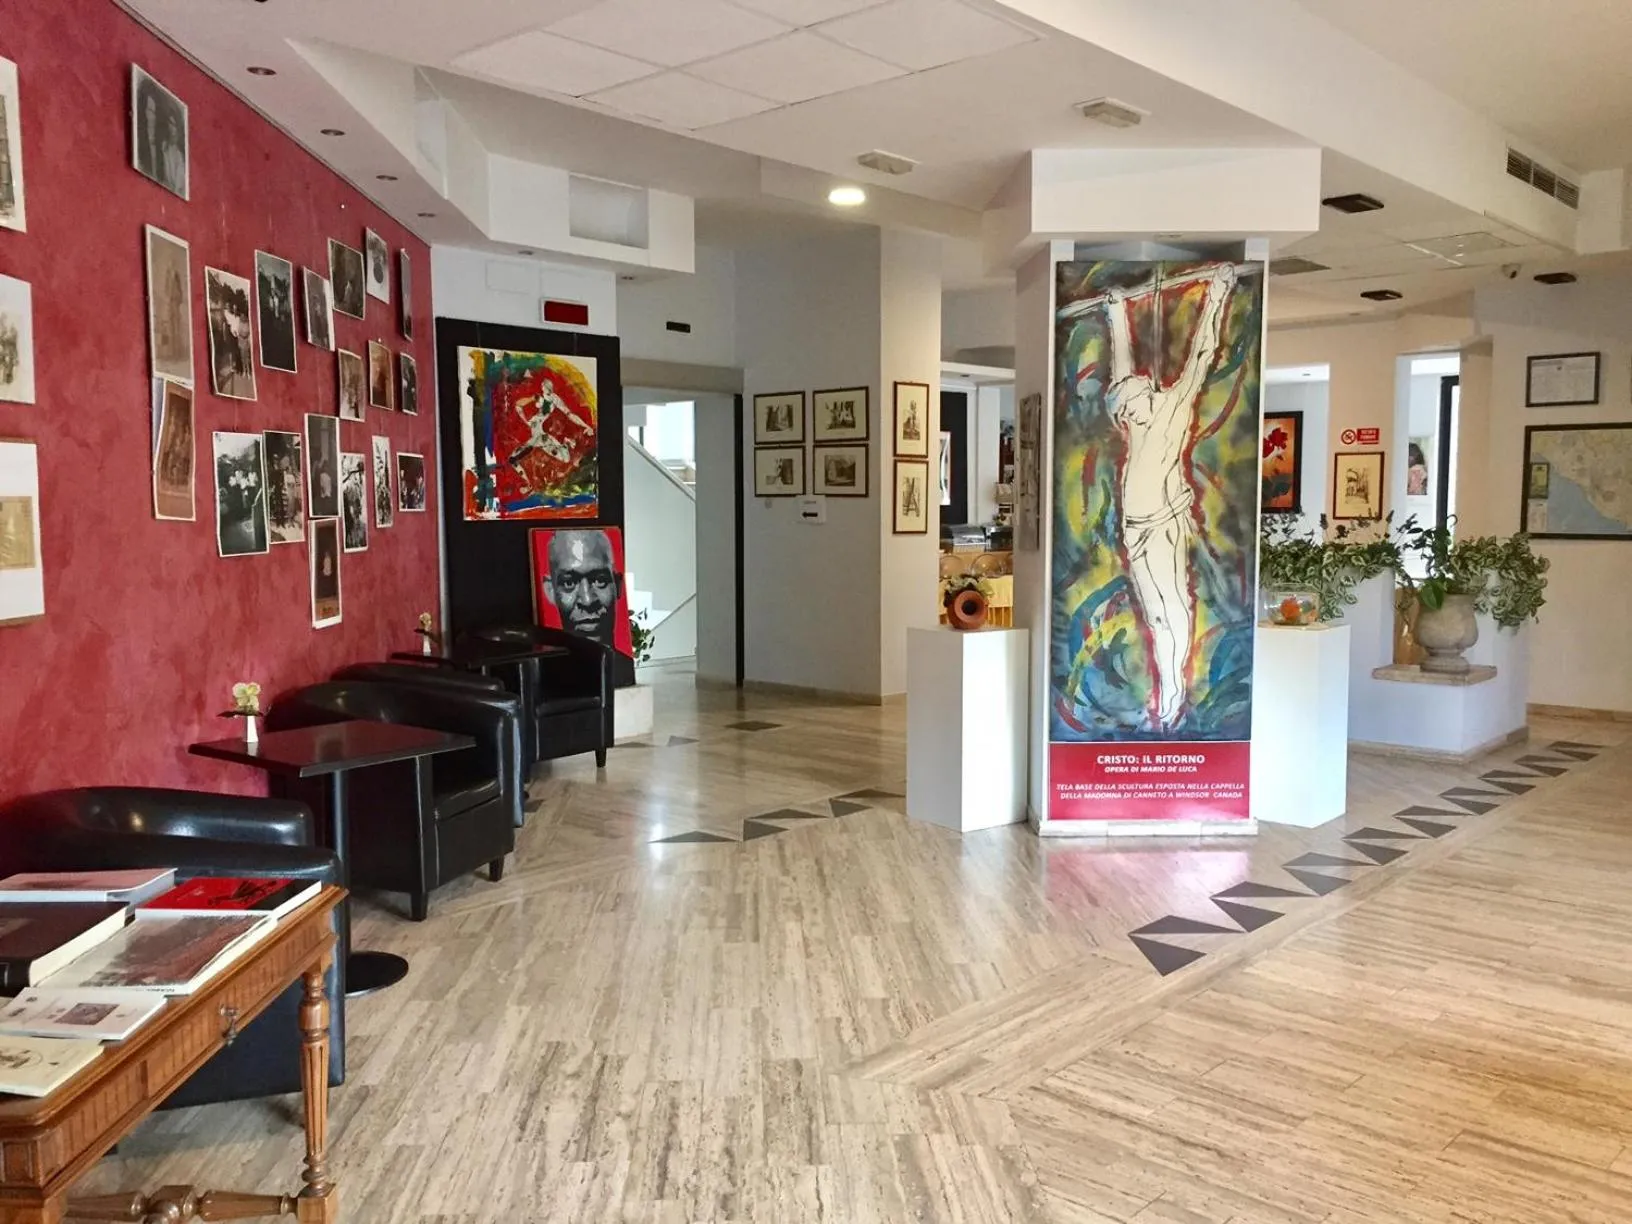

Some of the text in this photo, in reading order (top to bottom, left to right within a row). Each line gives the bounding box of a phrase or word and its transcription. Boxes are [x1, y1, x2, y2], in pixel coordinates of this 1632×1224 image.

[1097, 755, 1205, 764] CRISTO: IL RITORNO
